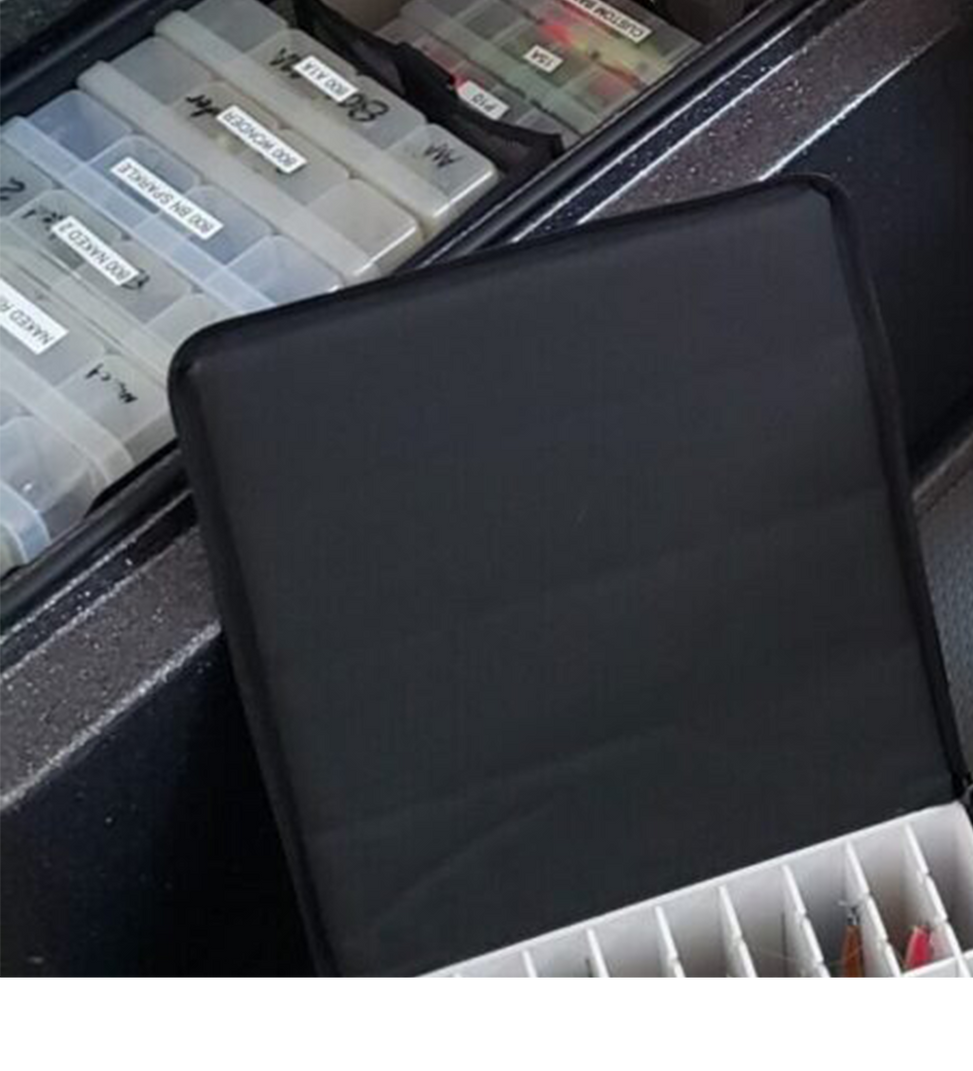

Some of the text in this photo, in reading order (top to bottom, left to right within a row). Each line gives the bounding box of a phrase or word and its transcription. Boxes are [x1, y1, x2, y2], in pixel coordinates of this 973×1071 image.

[592, 6, 643, 38] CUSTOM
[223, 111, 276, 151] WONDER
[117, 162, 176, 205] SPARKLE
[68, 229, 110, 265] NAKED
[9, 309, 55, 346] NAKED
